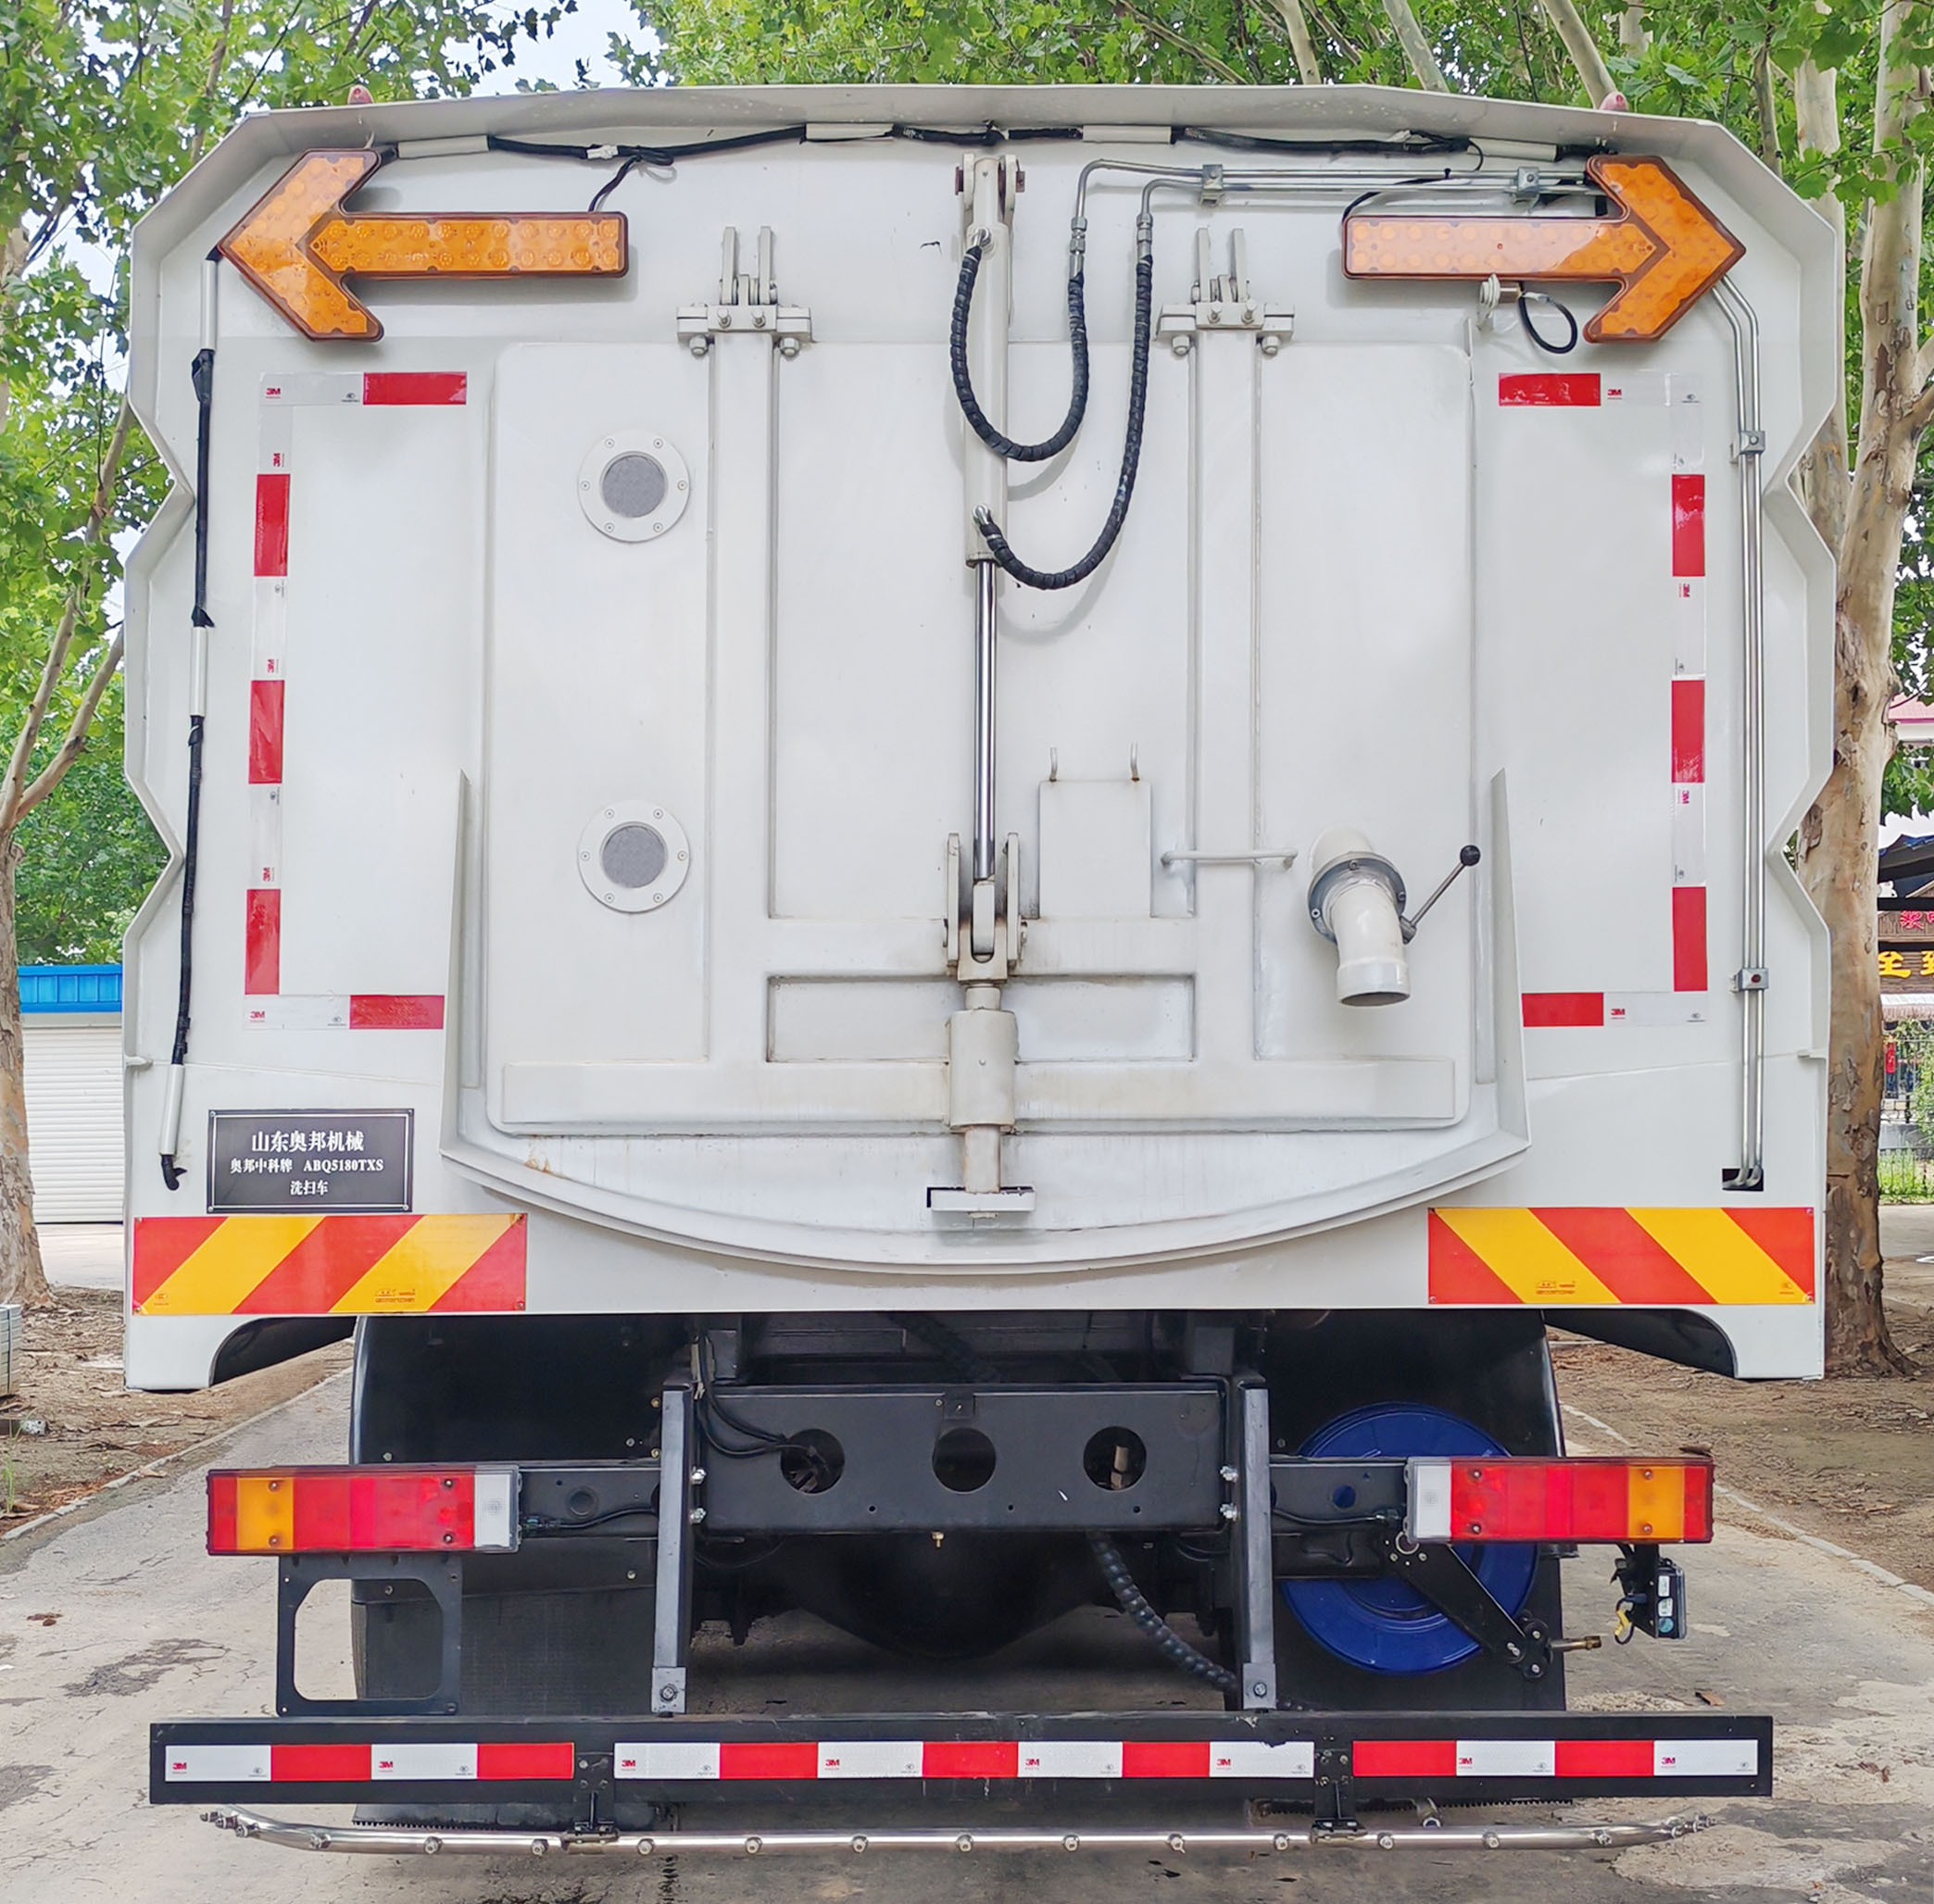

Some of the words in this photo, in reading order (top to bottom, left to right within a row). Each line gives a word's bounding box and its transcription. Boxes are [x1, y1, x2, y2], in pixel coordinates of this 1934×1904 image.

[1607, 388, 1622, 396] 3M
[273, 453, 281, 467] 3M
[1682, 584, 1690, 598] 3M
[267, 658, 275, 673] 3M
[1681, 791, 1689, 805] 3M
[262, 867, 270, 882] 3M
[250, 1010, 265, 1019] 3M
[1611, 1008, 1626, 1016] 3M
[251, 1130, 364, 1152] 山东奥邦机械
[231, 1159, 293, 1173] 奥邦中科牌
[303, 1159, 384, 1173] ABQ5180TXS
[290, 1180, 329, 1196] 洗扫车
[1662, 1757, 1676, 1765] 3M
